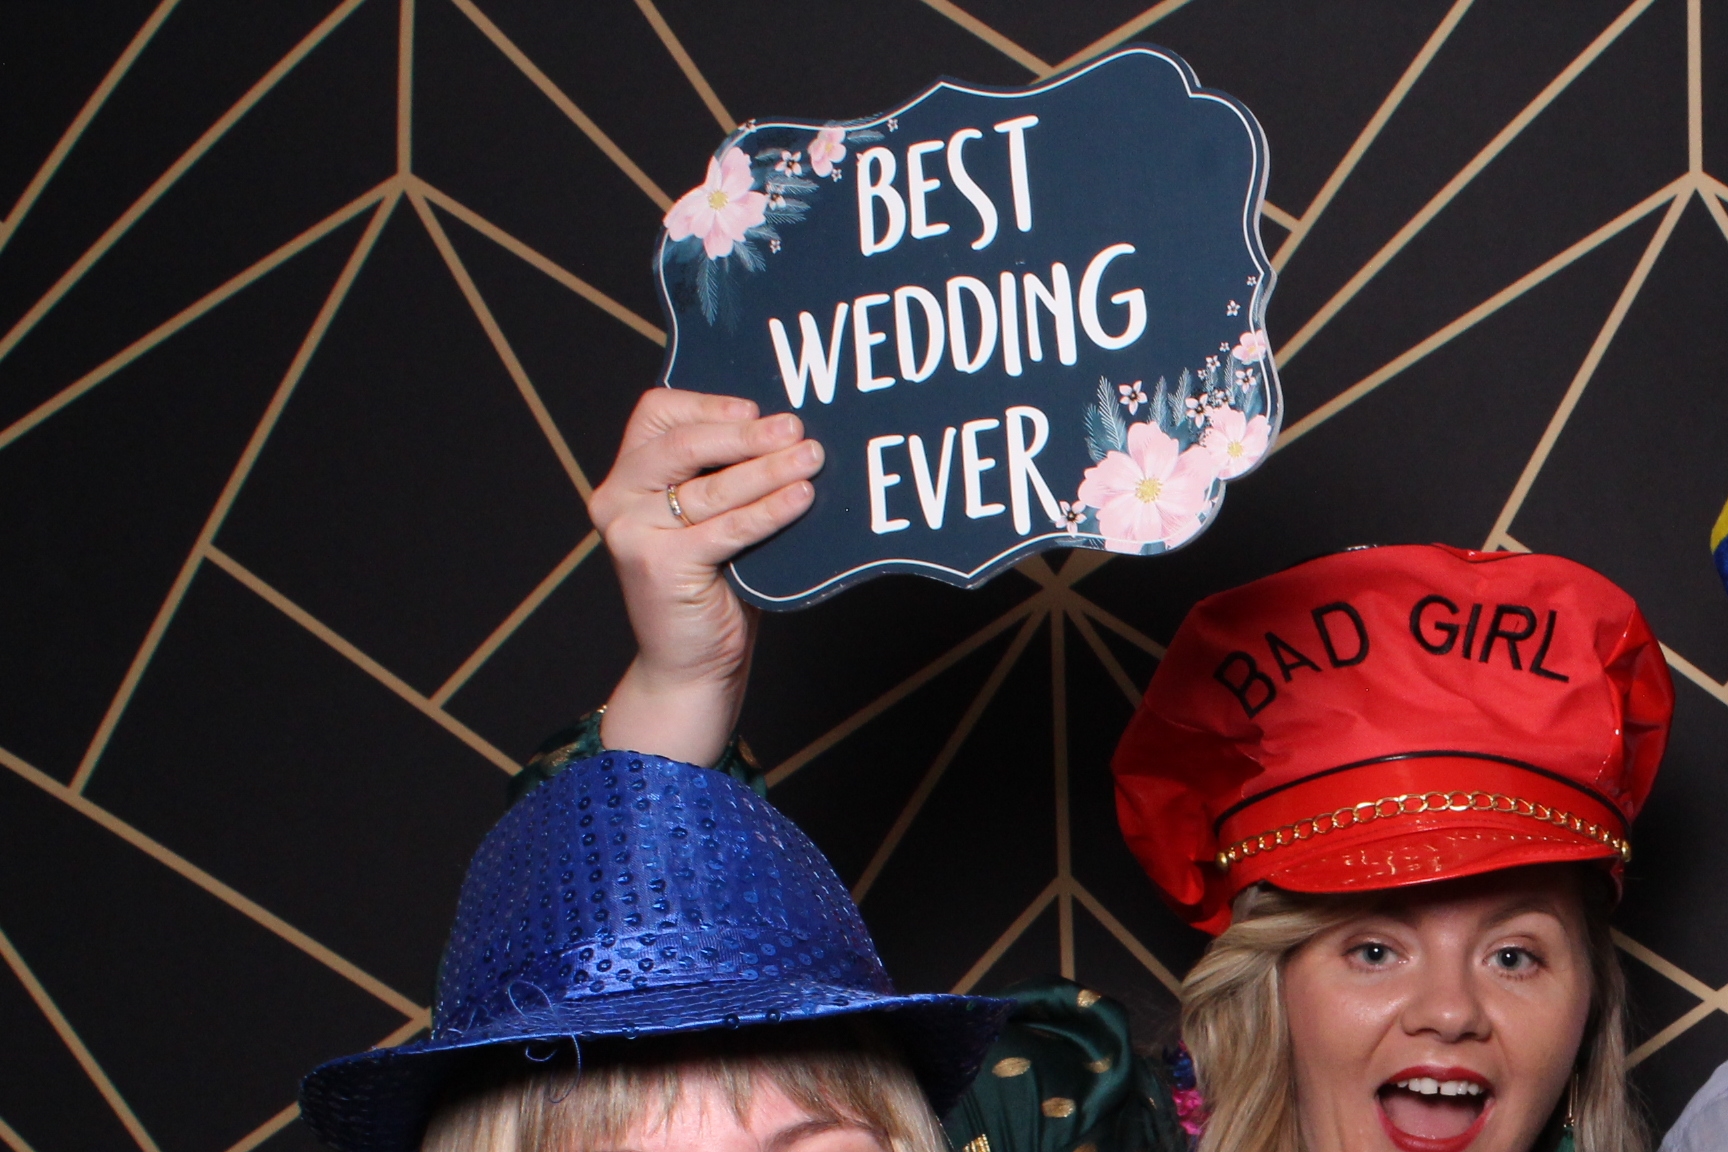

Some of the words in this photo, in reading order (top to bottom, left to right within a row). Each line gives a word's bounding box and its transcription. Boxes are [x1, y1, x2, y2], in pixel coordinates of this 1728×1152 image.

[856, 115, 1039, 256] BEST
[768, 243, 1148, 409] WEDDING
[867, 405, 1062, 536] EVER
[1213, 600, 1370, 719] BAD
[1409, 594, 1570, 684] GIRL
